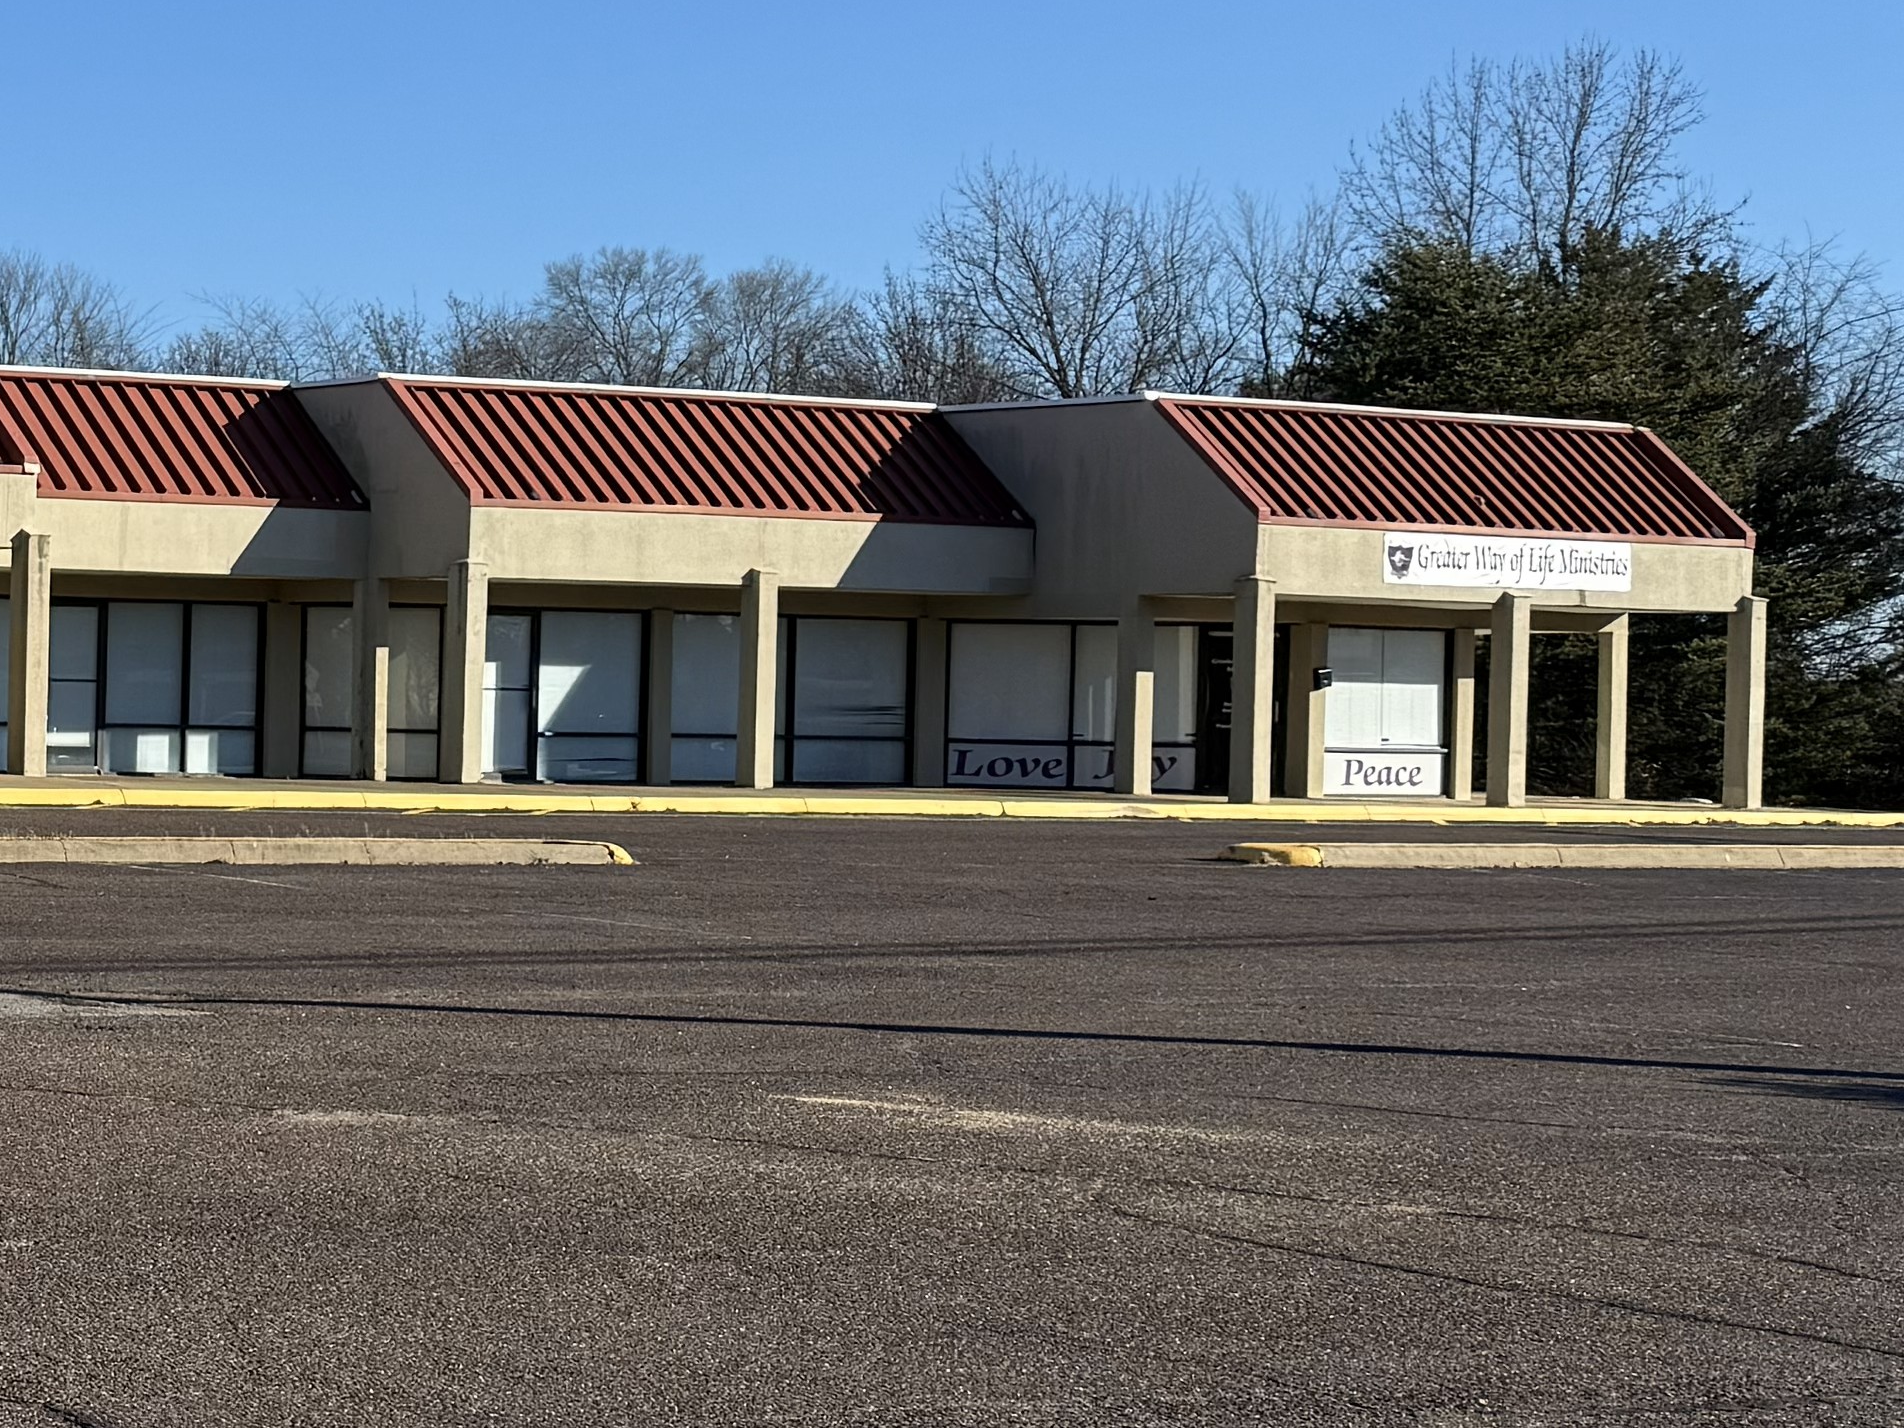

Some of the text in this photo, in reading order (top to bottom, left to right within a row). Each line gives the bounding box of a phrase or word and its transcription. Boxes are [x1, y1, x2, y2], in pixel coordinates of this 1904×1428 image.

[1509, 542, 1528, 584] of
[1529, 544, 1556, 585] Life
[950, 748, 1065, 781] Love
[1340, 759, 1424, 787] Peace
